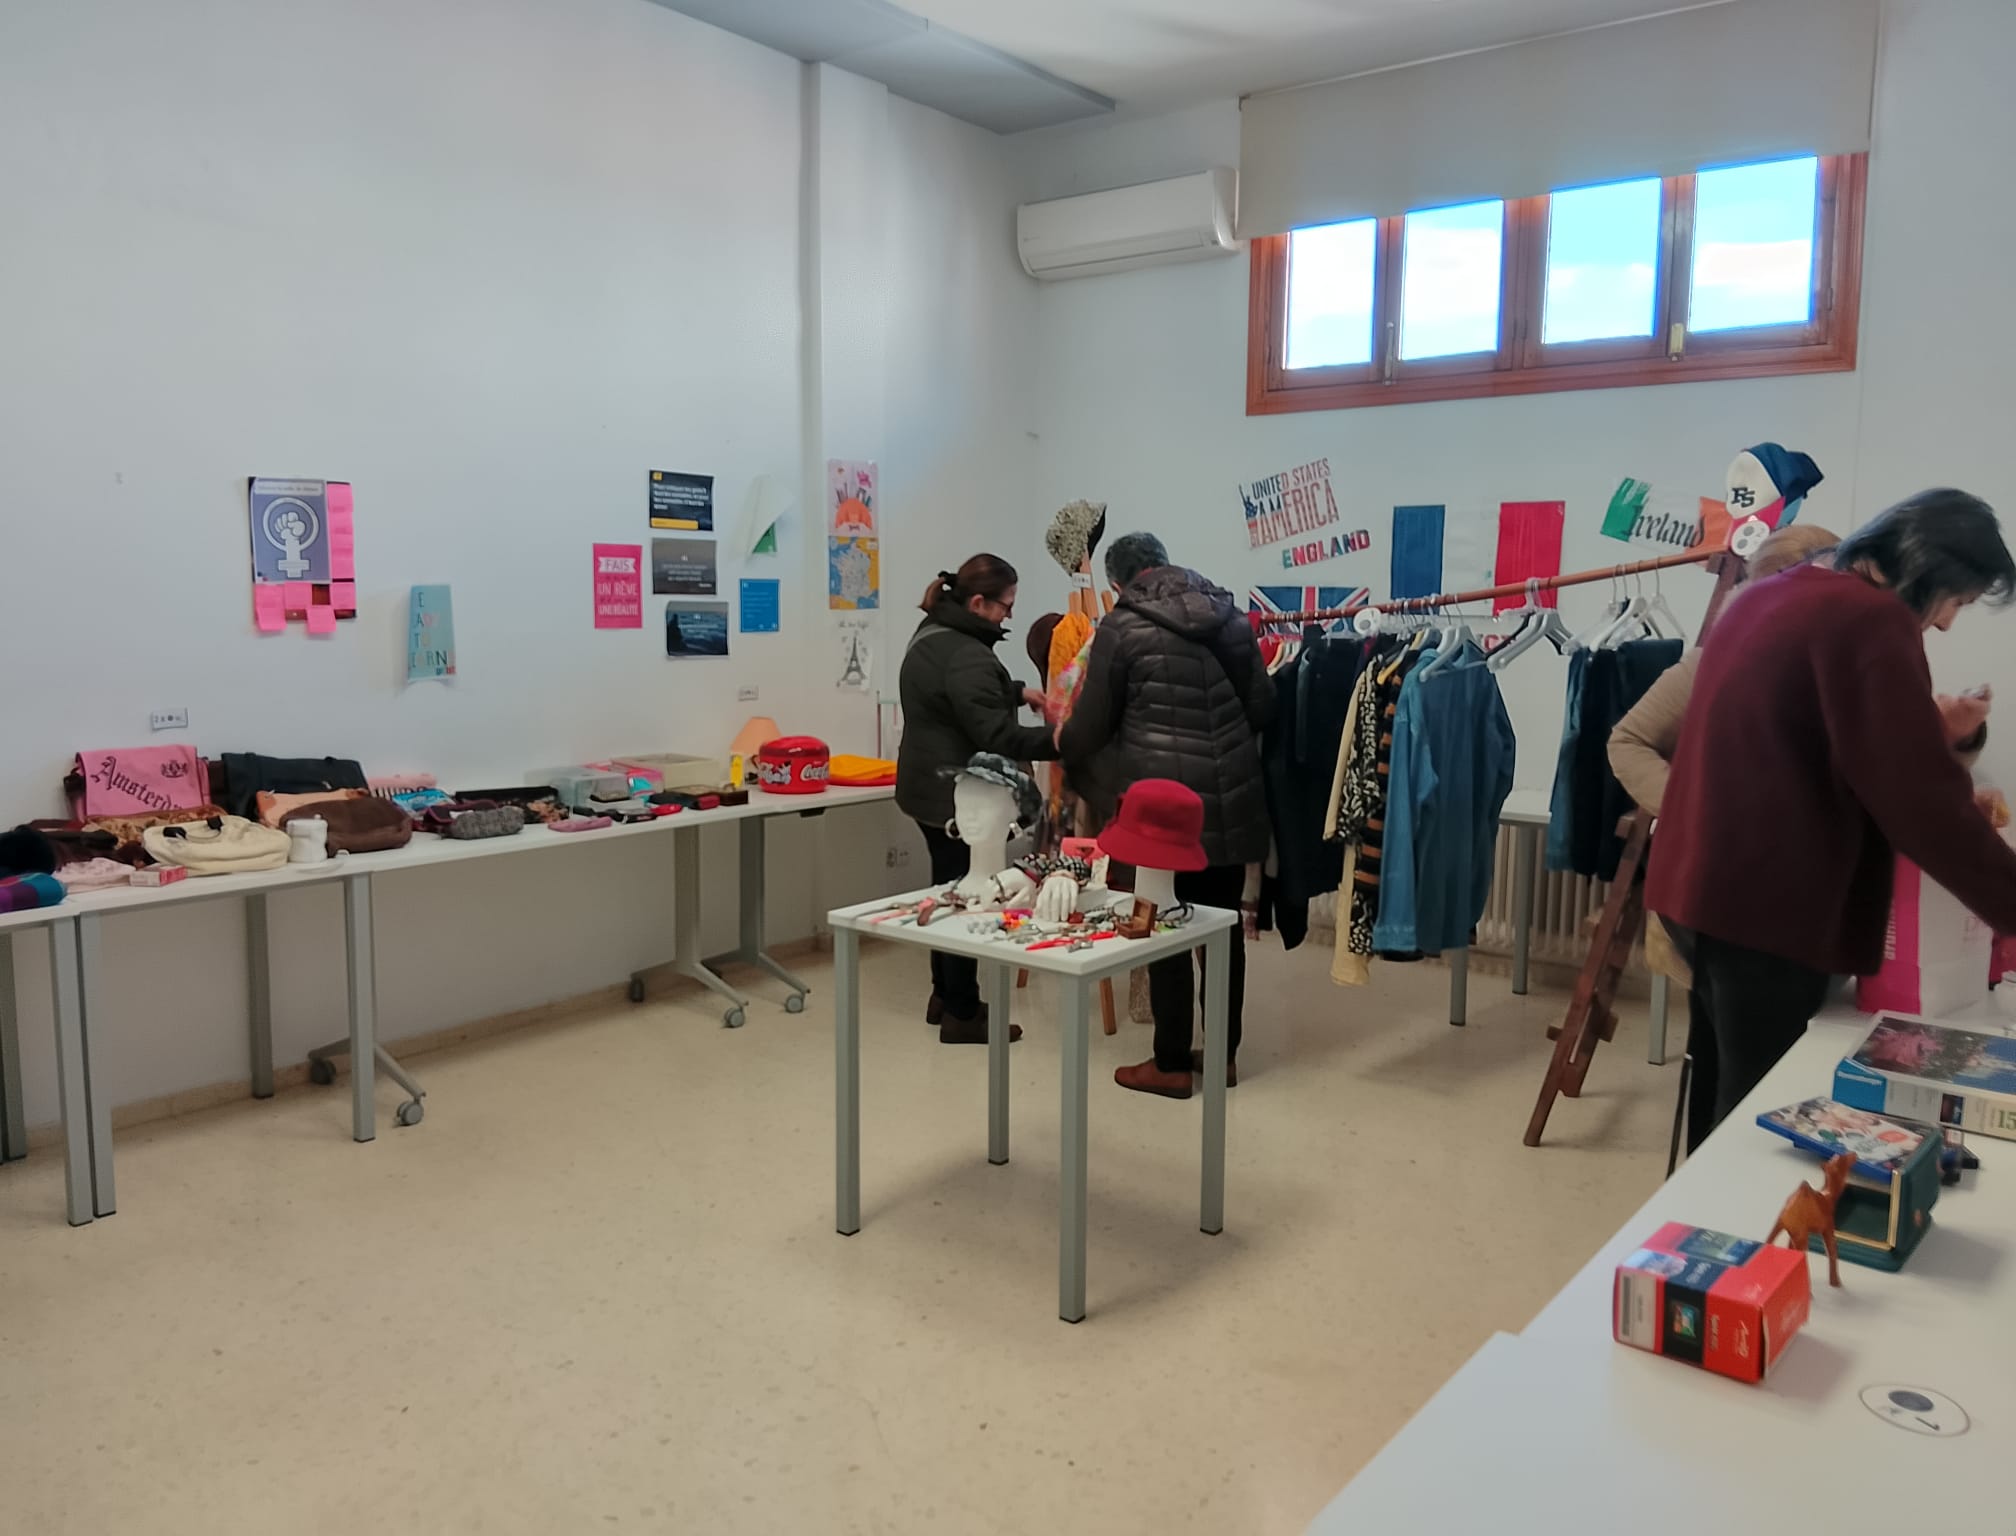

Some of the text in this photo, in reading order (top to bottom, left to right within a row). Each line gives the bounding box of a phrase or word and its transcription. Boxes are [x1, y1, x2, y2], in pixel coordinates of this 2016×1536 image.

[1252, 457, 1331, 499] UNITED STATES
[1258, 479, 1340, 545] AMERICA
[1621, 505, 1706, 548] Ireland
[605, 558, 631, 571] FAIS
[1282, 529, 1371, 569] ENGLAND
[90, 756, 183, 811] Amsterd
